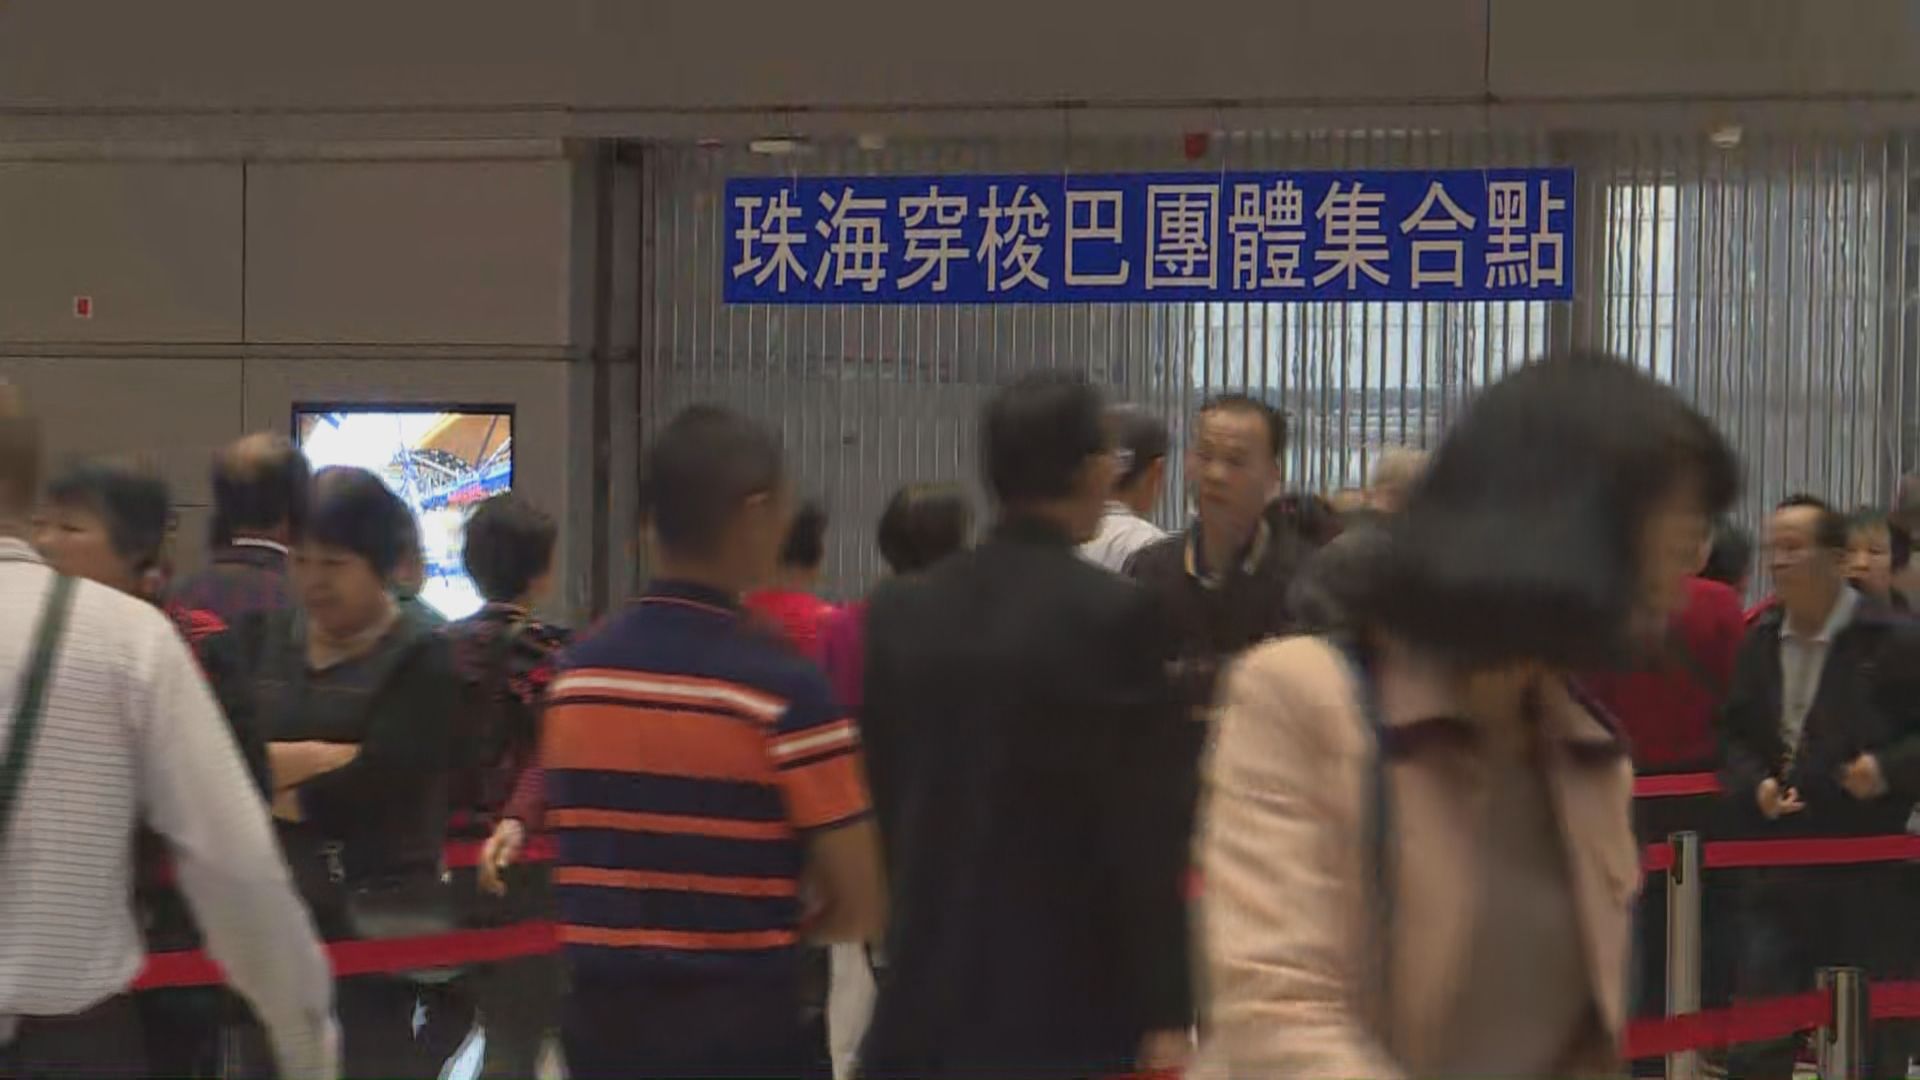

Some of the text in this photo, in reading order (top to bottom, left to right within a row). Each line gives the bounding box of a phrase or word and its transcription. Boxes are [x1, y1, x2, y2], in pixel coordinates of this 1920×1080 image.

[732, 180, 1564, 292] 珠海穿梭巴團體集合點
